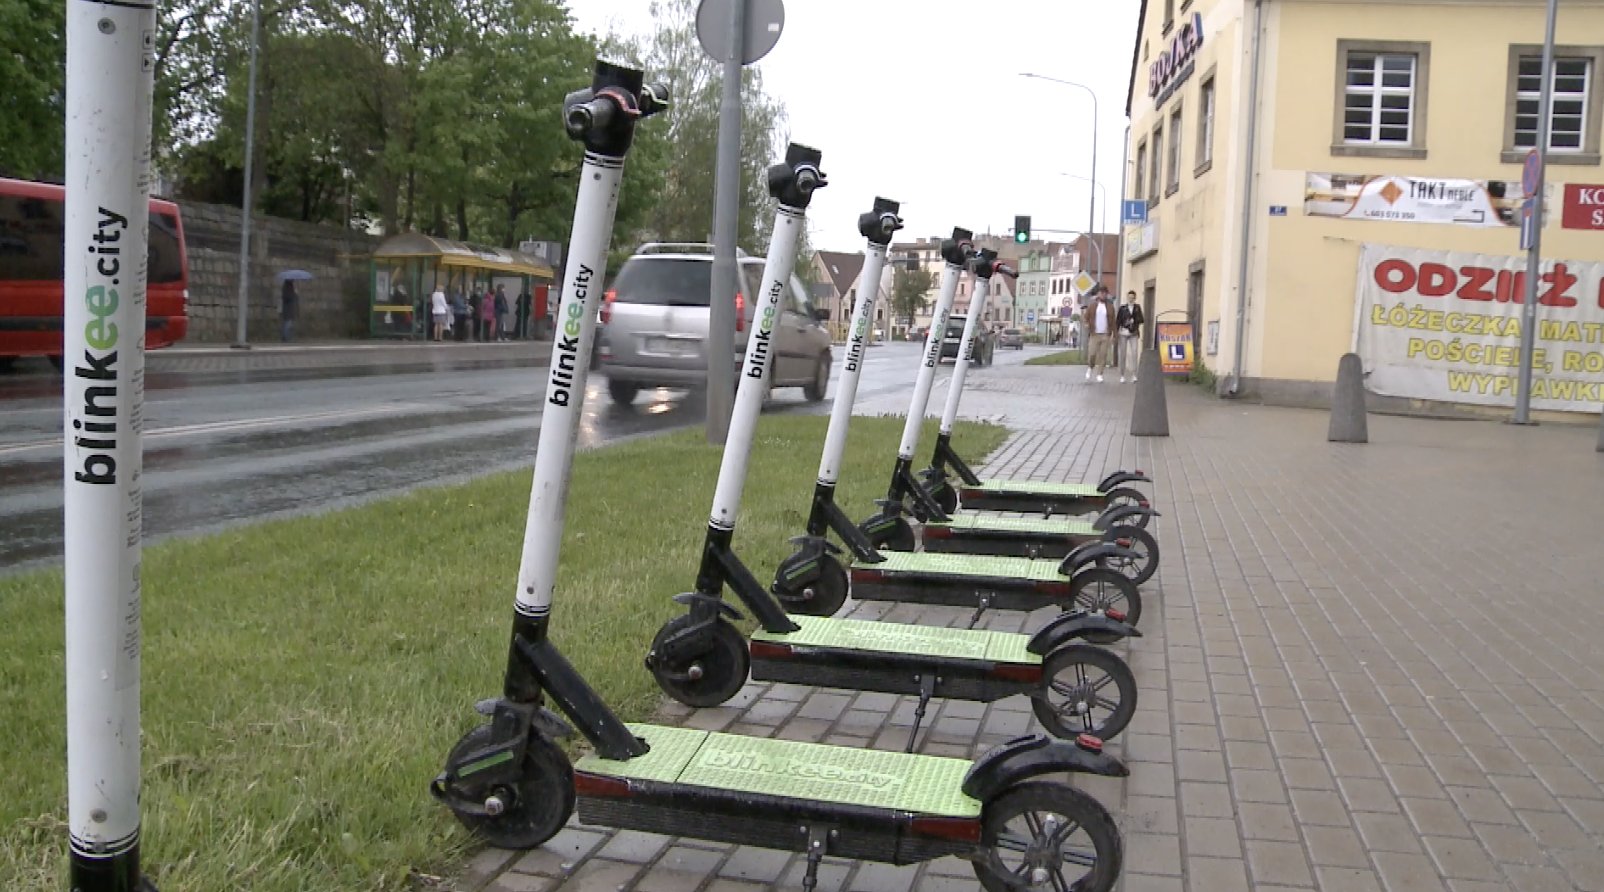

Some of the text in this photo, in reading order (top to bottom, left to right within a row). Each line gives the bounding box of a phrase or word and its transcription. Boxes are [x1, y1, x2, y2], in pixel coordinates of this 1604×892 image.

[1409, 180, 1446, 199] TAKT
[1131, 203, 1141, 217] L
[549, 264, 594, 407] blinkee.city
[747, 280, 783, 379] blinkee.city
[1539, 319, 1604, 344] MAT
[73, 205, 128, 485] blinkee.city
[1171, 345, 1183, 359] L
